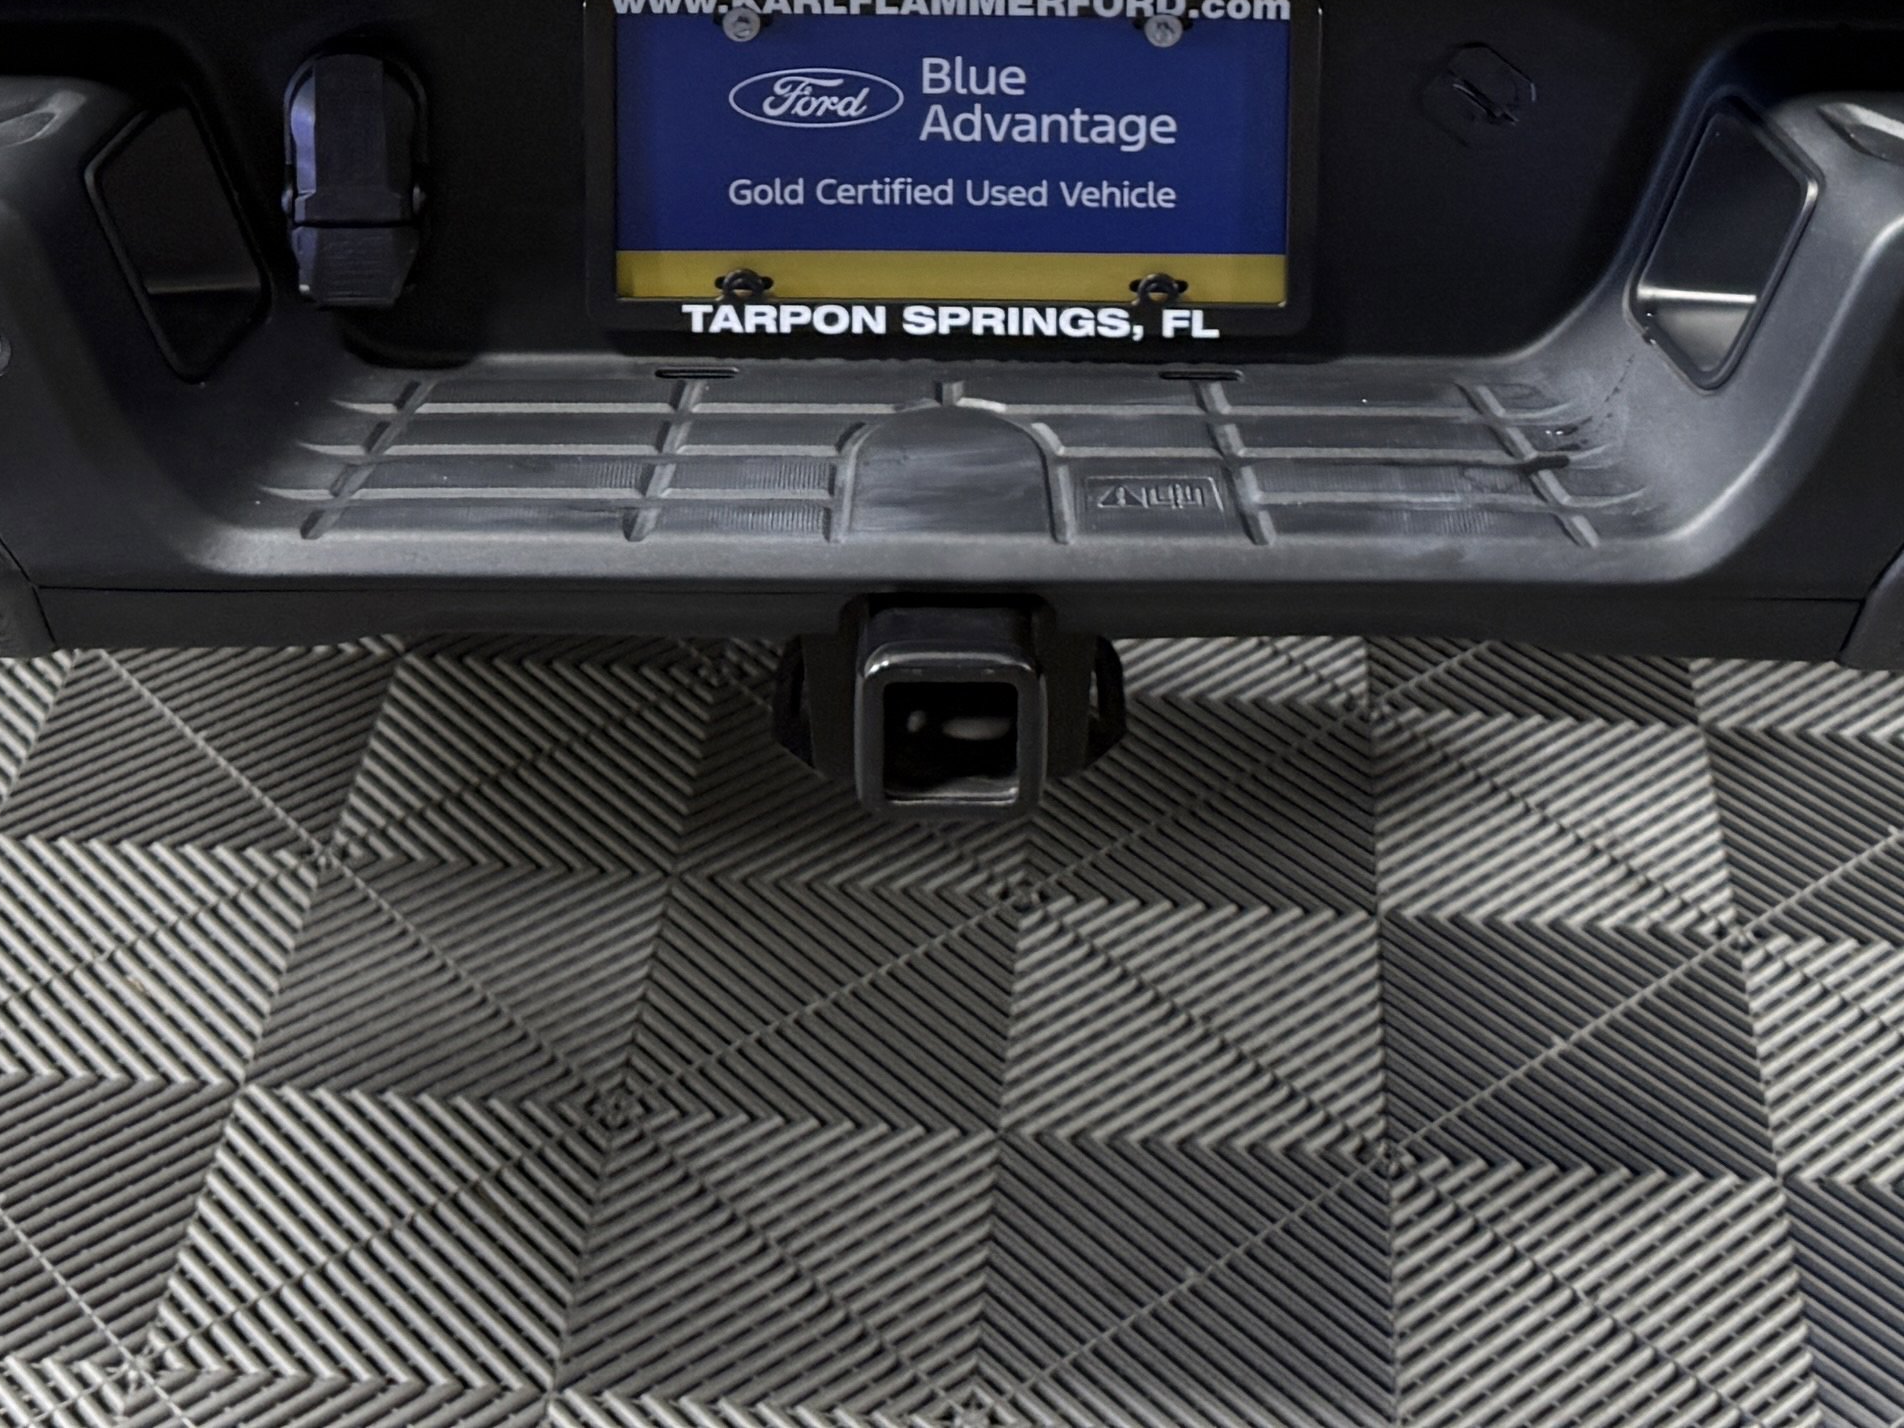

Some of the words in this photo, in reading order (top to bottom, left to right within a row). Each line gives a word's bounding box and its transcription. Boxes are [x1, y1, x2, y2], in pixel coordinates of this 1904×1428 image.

[921, 56, 1026, 96] Blue
[762, 76, 870, 120] Ford
[919, 104, 1177, 152] Advantage
[728, 178, 804, 206] Gold
[816, 178, 954, 207] Certified
[966, 180, 1048, 208] Used
[1060, 181, 1177, 210] Vehicle
[682, 304, 887, 336] TARPON
[903, 306, 1144, 343] SPRINGS,
[1161, 310, 1220, 340] FL
